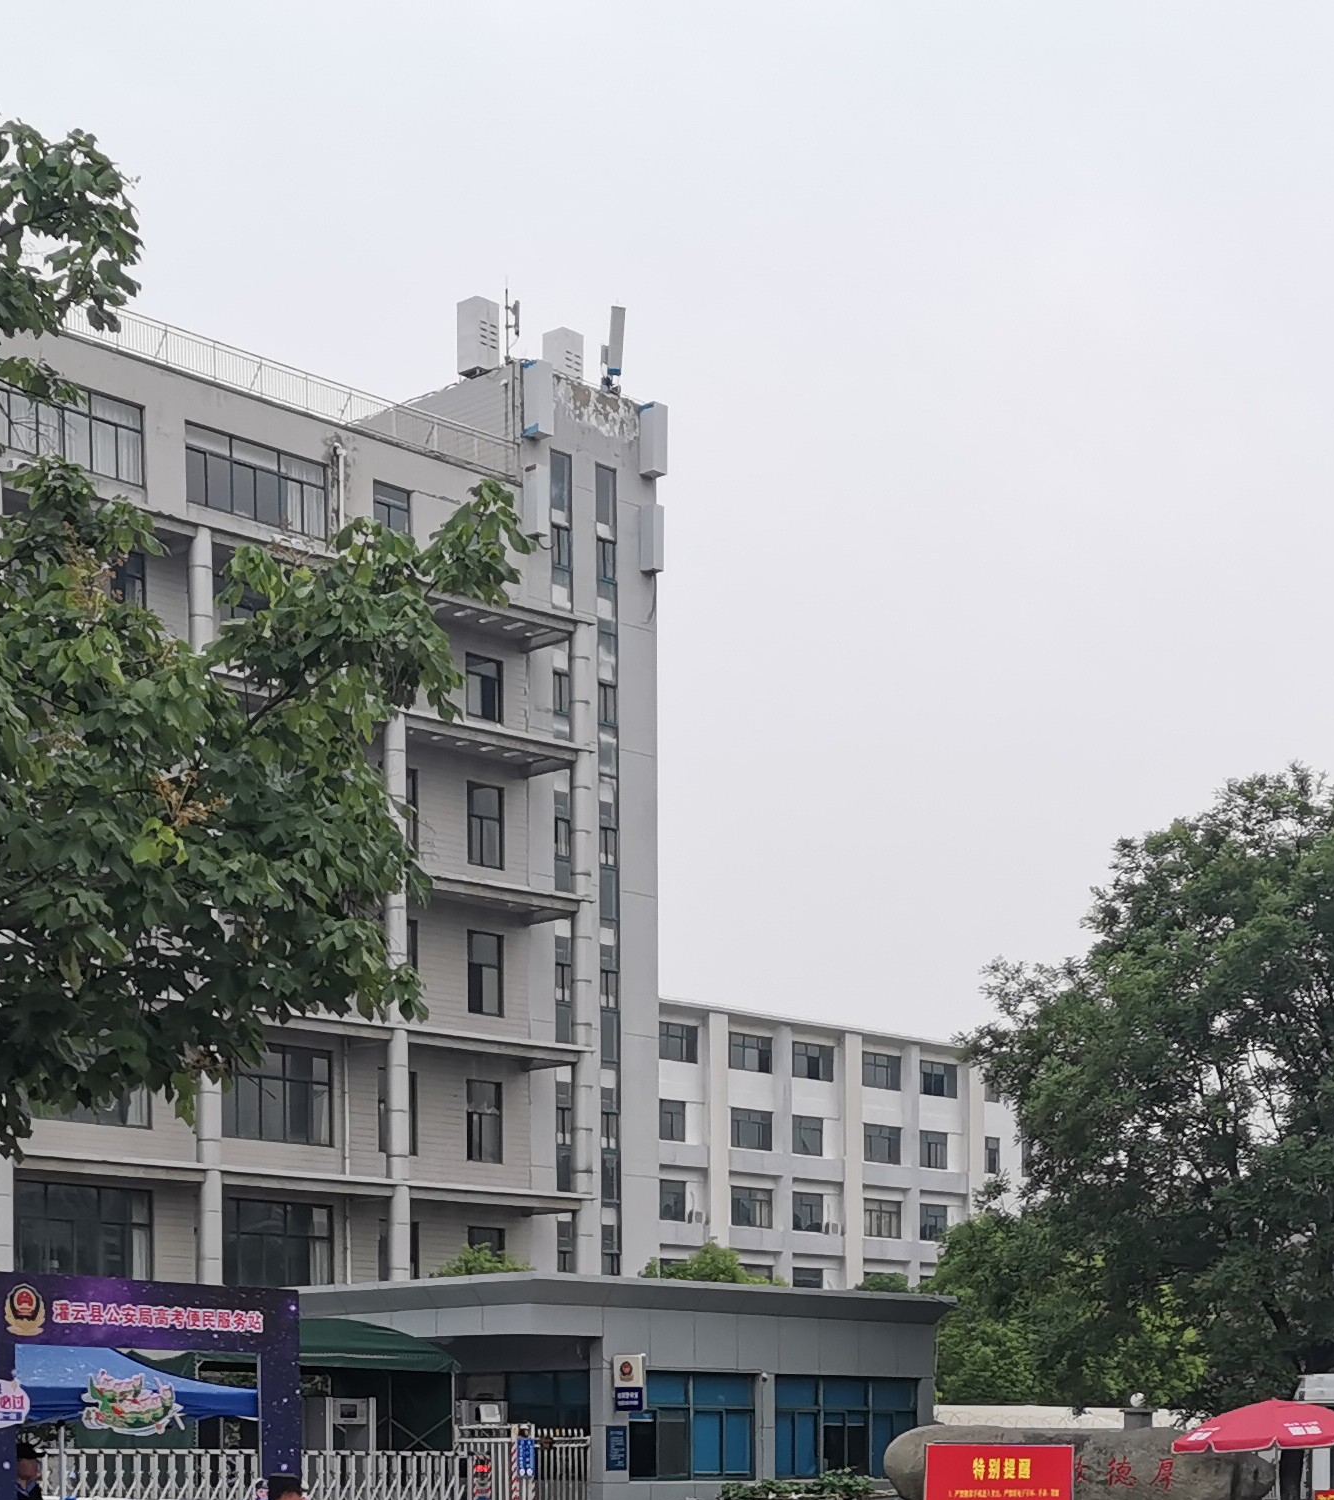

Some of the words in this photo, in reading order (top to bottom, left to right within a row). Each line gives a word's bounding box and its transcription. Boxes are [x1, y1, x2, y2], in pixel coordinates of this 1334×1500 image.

[53, 1301, 264, 1332] 灌云县公安局高考便民服务站
[972, 1457, 1031, 1481] 特别提醒
